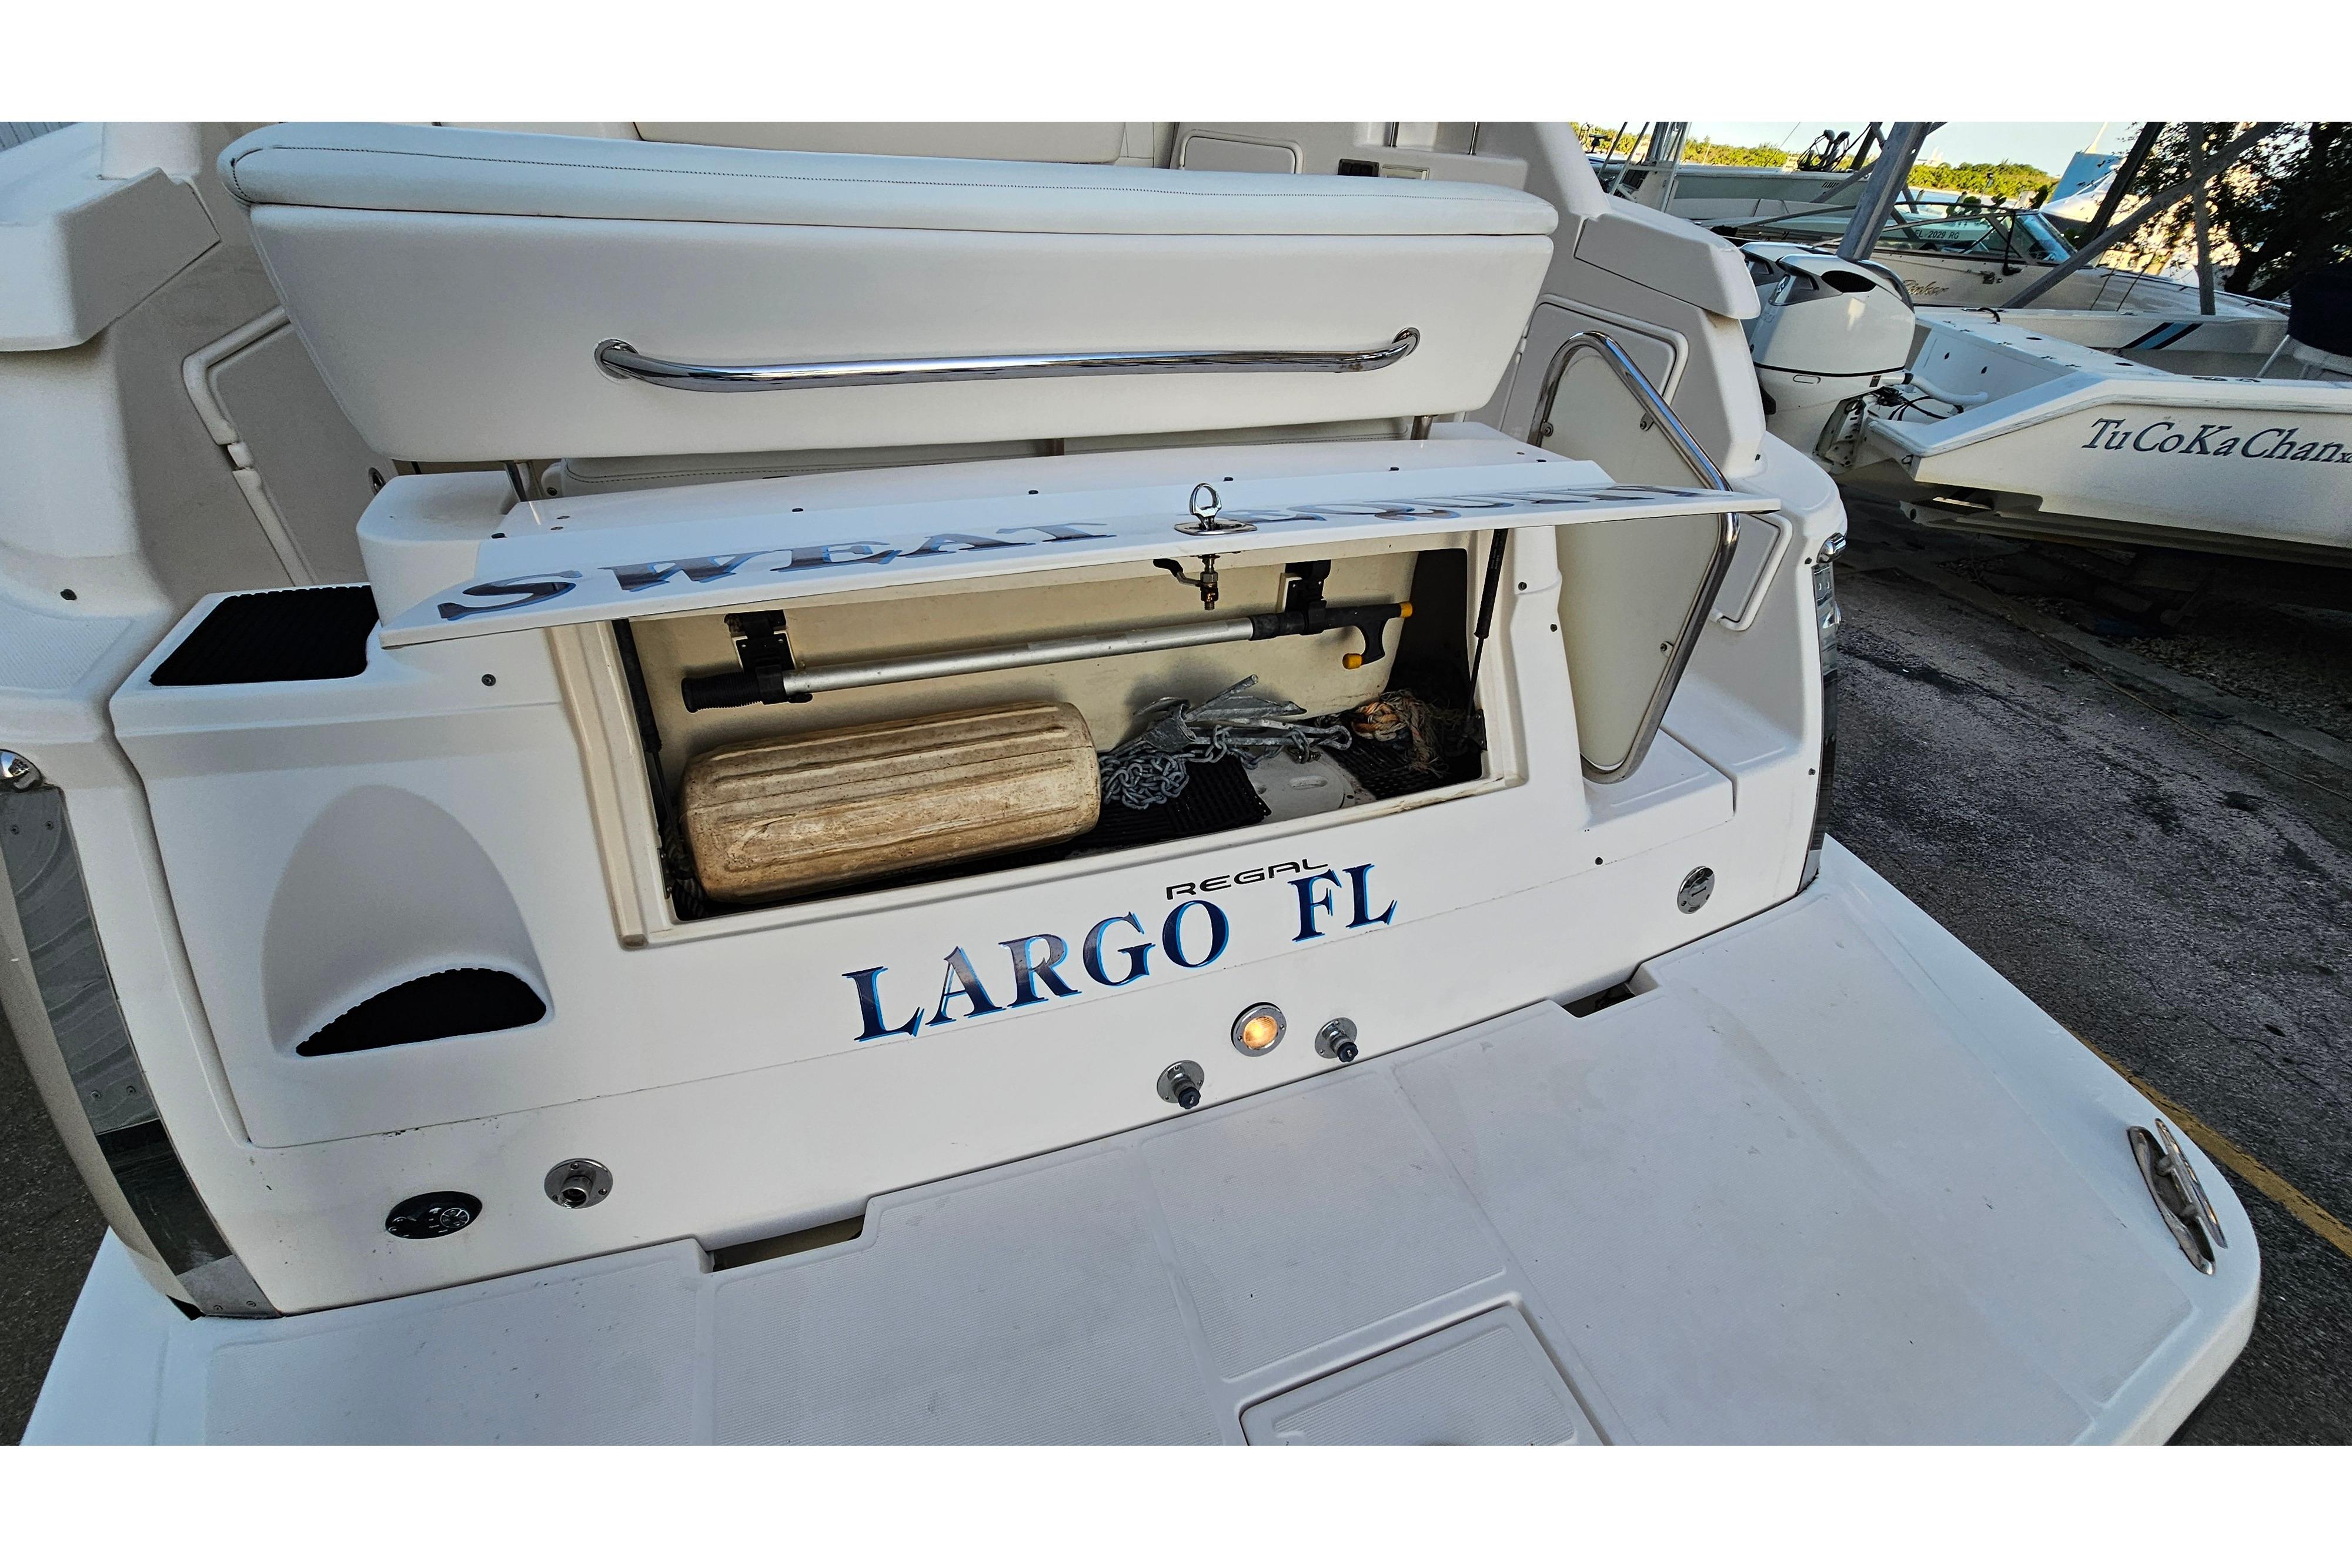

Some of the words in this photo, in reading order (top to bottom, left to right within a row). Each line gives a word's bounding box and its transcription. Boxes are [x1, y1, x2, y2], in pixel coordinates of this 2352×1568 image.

[1927, 230, 1946, 239] 2029
[437, 523, 1117, 621] SWEAT
[1166, 858, 1328, 900] REGAL
[841, 900, 1230, 1042] LARGO
[1288, 863, 1398, 942] FL
